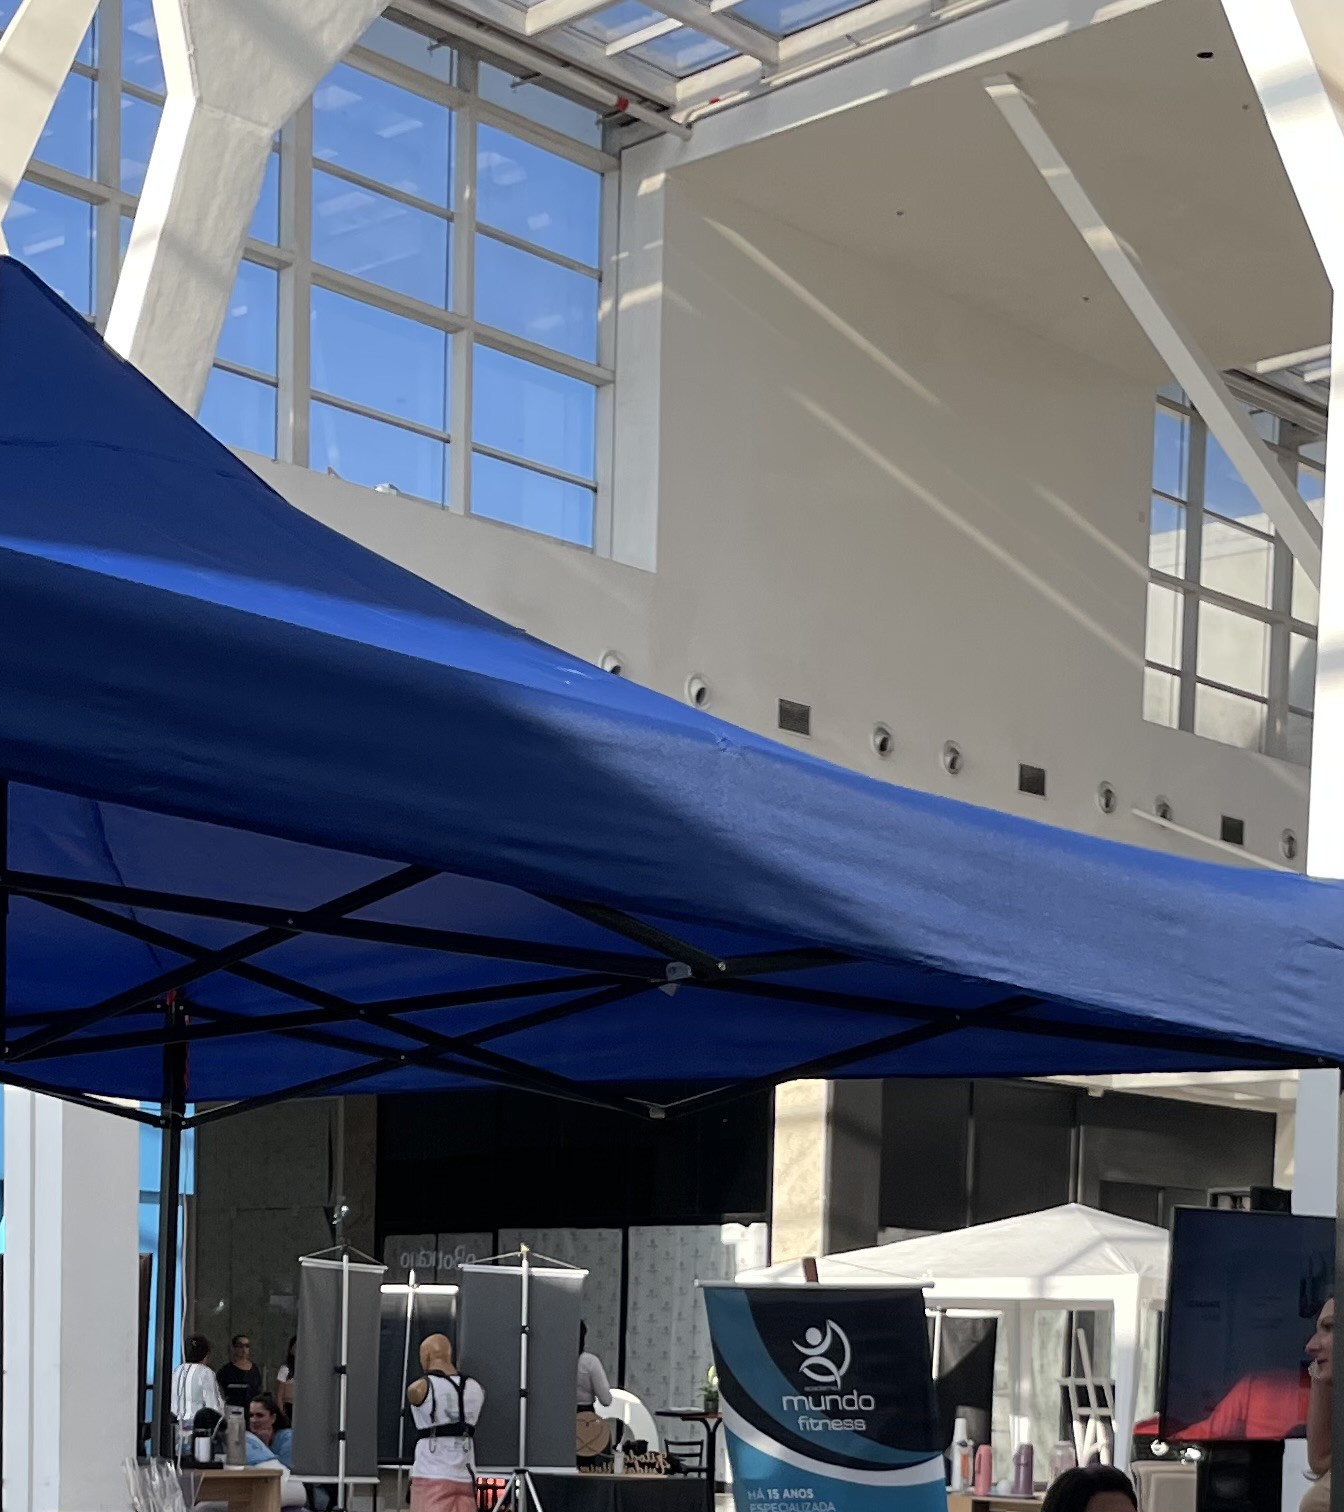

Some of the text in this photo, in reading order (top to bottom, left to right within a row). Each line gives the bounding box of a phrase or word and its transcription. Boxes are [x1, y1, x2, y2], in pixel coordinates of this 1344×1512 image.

[782, 1389, 875, 1411] mundo
[798, 1415, 867, 1432] fitness
[747, 1488, 814, 1500] HÁ 15 ANOS
